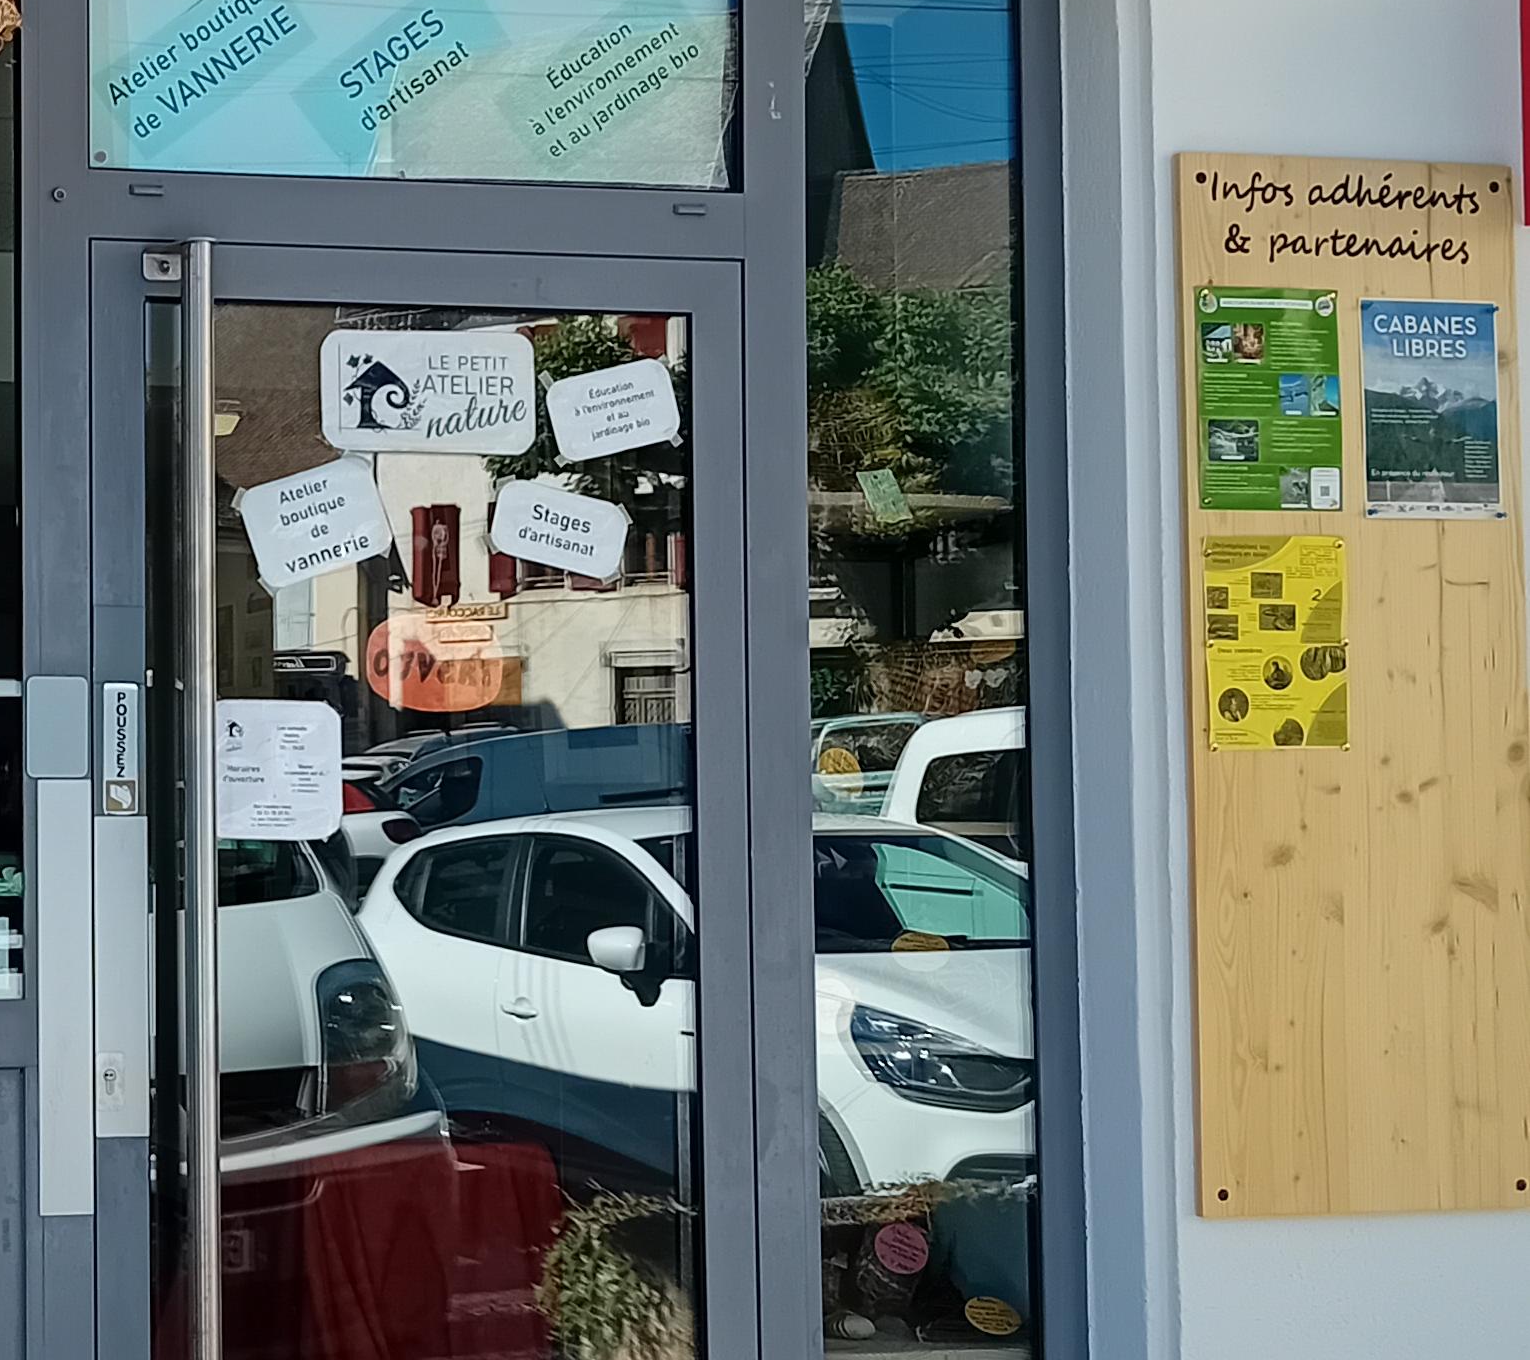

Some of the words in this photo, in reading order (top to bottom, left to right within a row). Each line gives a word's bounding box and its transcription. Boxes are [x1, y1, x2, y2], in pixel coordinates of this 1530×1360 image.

[133, 113, 161, 138] de
[156, 5, 297, 114] VANNERIE
[340, 9, 444, 99] STAGES
[546, 24, 632, 89] Éducation
[109, 45, 178, 106] Atelier
[361, 41, 469, 131] d'artisanat
[529, 119, 546, 135] à
[544, 22, 680, 125] l'environnement
[549, 139, 567, 157] et
[569, 124, 591, 144] au
[591, 66, 669, 131] jardinage
[670, 44, 699, 70] bio
[1211, 171, 1294, 212] Infos
[1308, 173, 1480, 215] adhérents
[1224, 223, 1252, 254] &
[1269, 228, 1470, 264] partenaires
[1373, 313, 1477, 337] CABANES
[427, 355, 449, 371] LE
[458, 355, 510, 372] PETIT
[1392, 338, 1467, 360] LIBRES
[421, 375, 514, 396] ATELIER
[426, 393, 528, 439] nature
[636, 417, 650, 428] bio
[278, 477, 328, 505] Atelier
[279, 494, 346, 528] boutique
[310, 522, 330, 541] de
[531, 503, 592, 535] Stages
[284, 533, 371, 575] vannerie
[517, 525, 596, 558] d'artisanat
[116, 692, 127, 778] POUSSEZ
